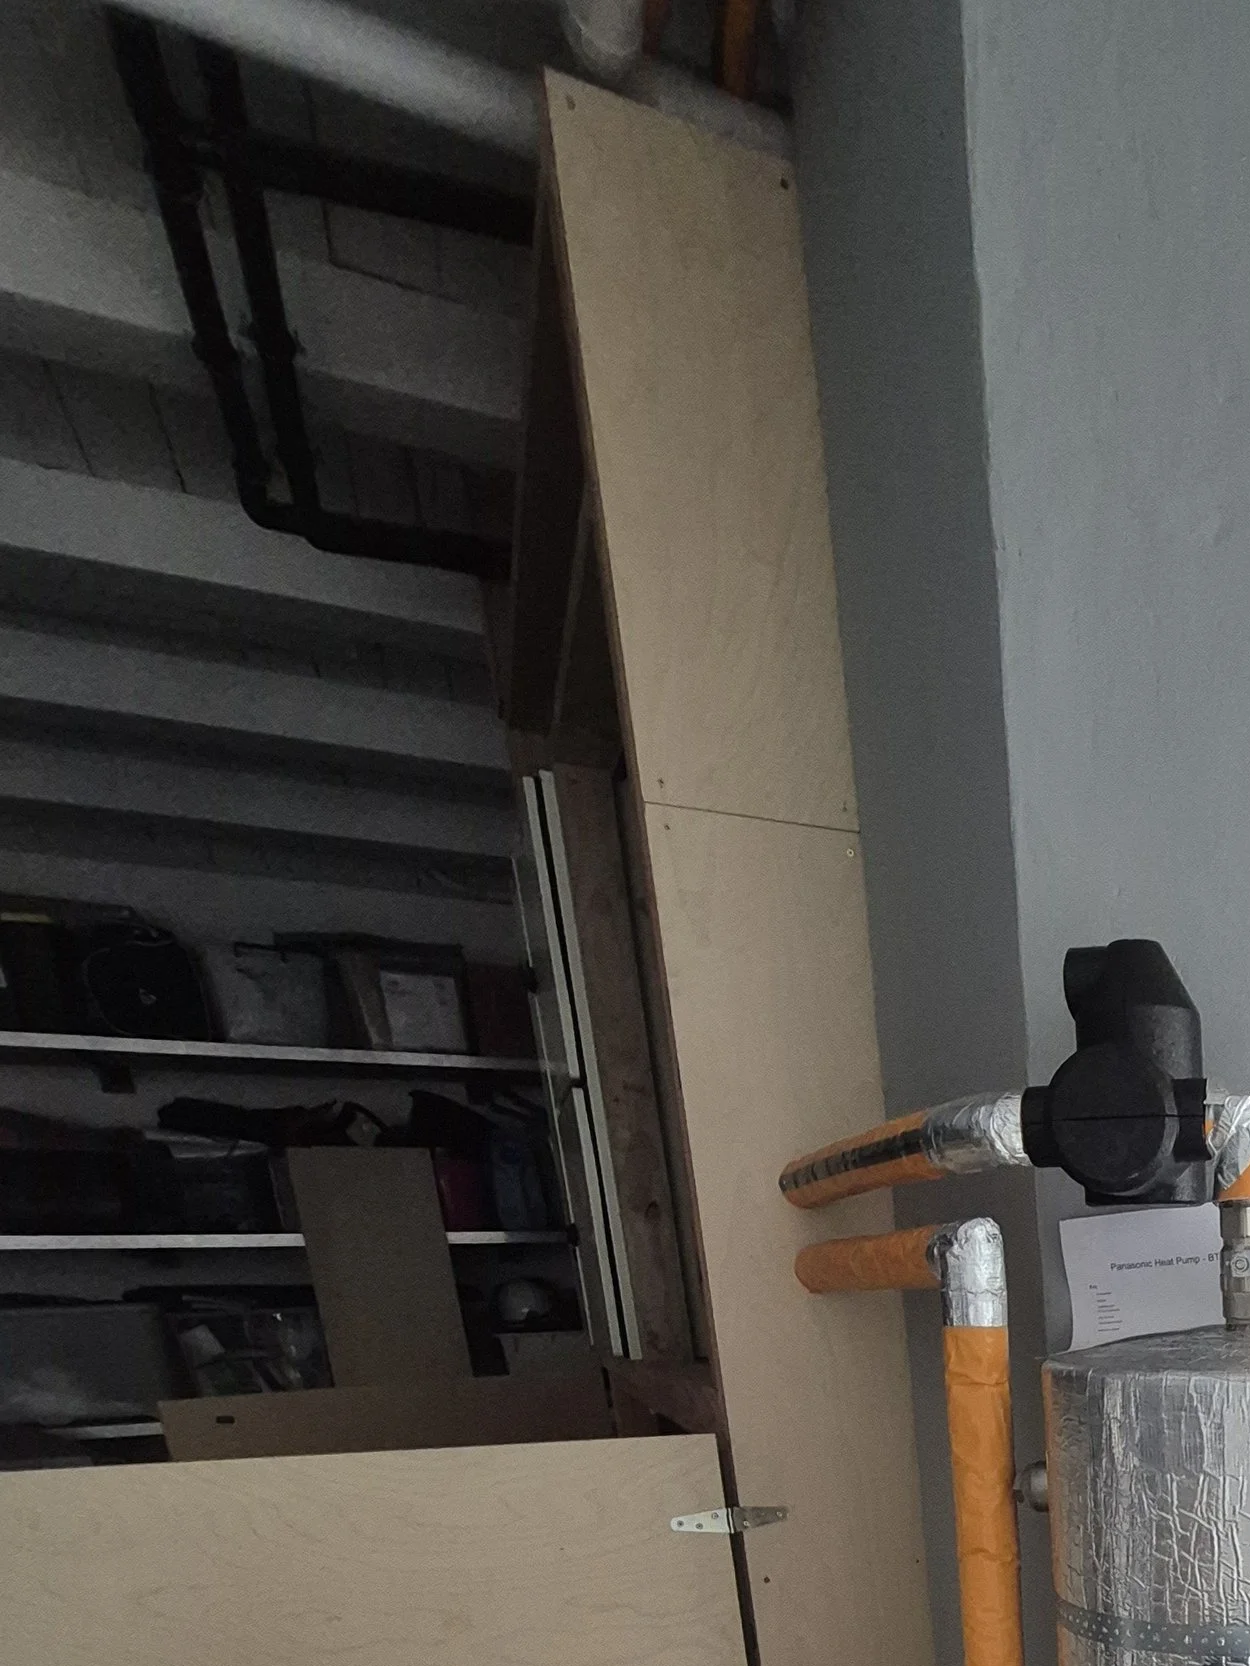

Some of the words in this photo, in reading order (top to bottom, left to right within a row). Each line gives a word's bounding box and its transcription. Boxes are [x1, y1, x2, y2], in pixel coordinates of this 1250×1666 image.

[1110, 1260, 1152, 1271] Panasonic
[1154, 1258, 1174, 1267] Heat
[1176, 1256, 1200, 1265] Pump
